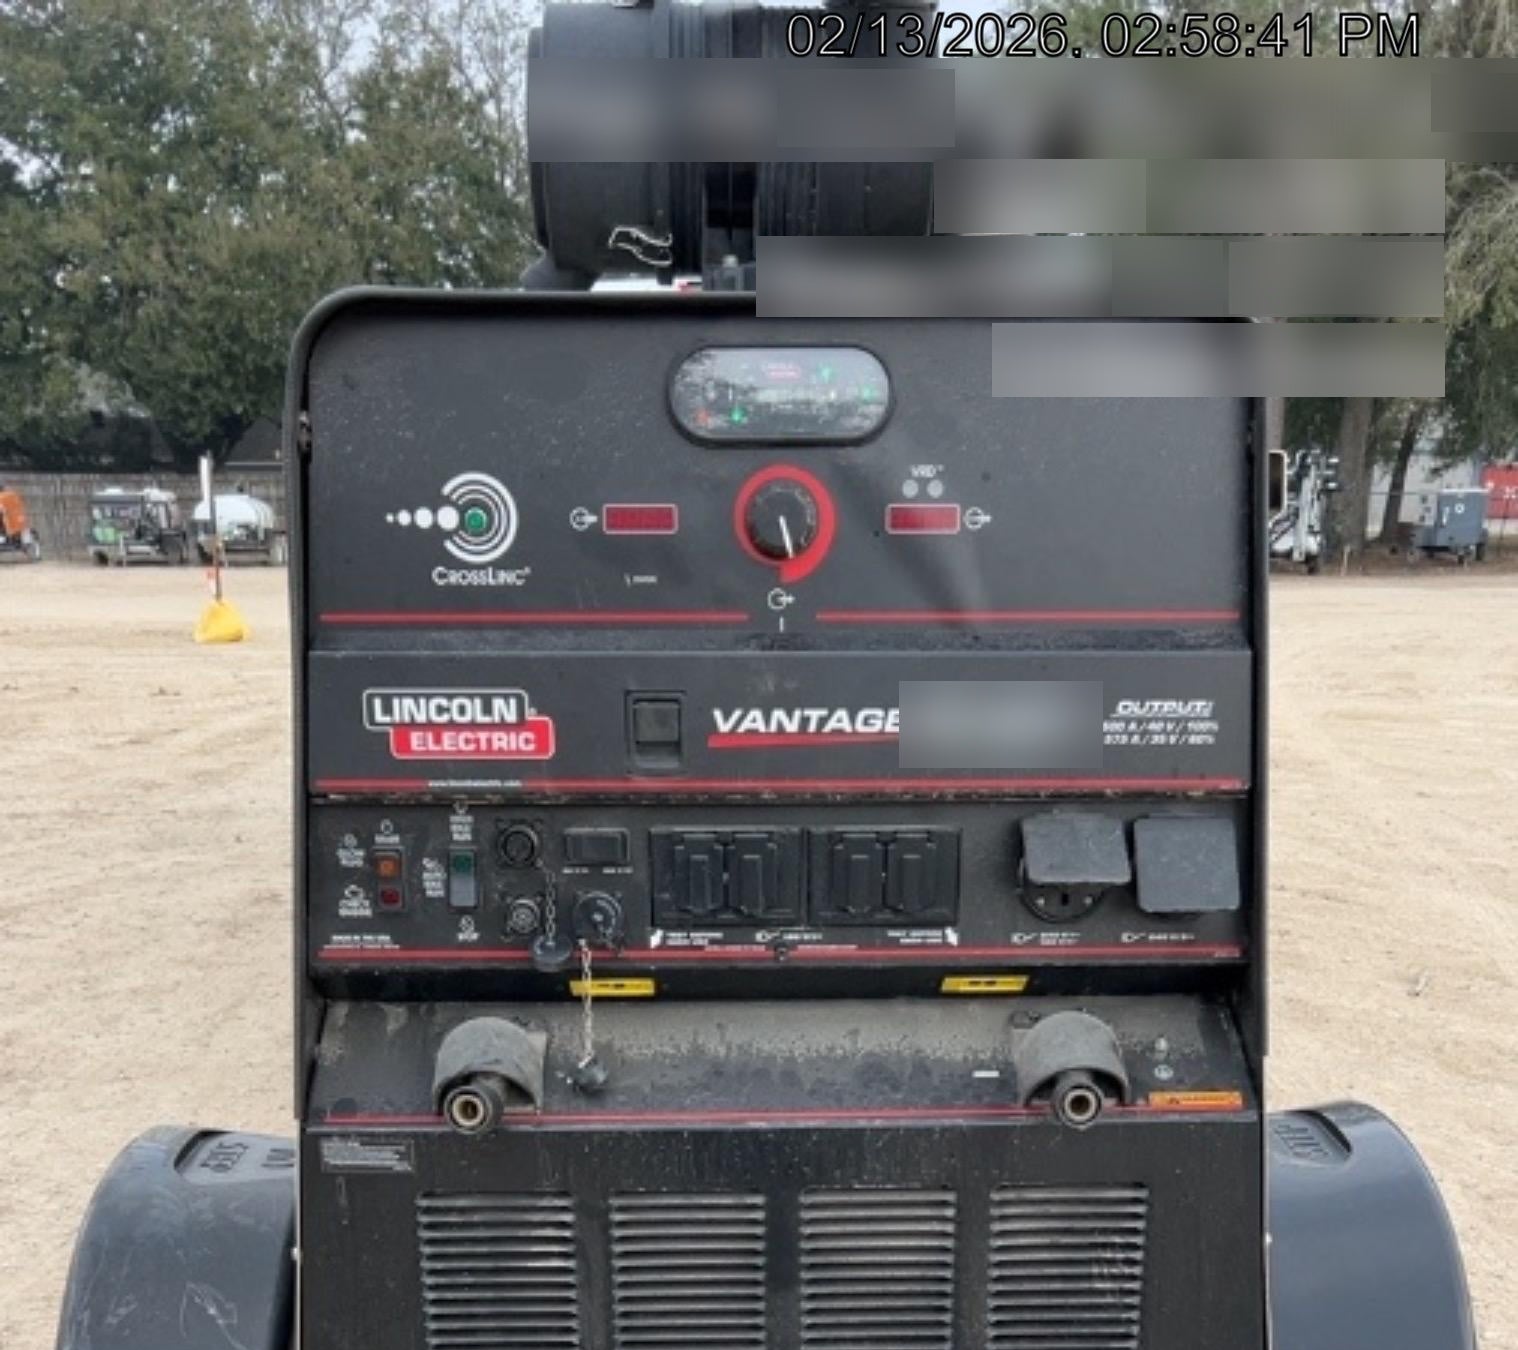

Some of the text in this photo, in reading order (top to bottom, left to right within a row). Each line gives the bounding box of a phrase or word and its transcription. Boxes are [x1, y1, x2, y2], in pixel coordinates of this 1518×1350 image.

[373, 697, 517, 723] LINCOLN
[713, 707, 899, 733] VANTAGE
[410, 731, 537, 752] ELECTRIC
